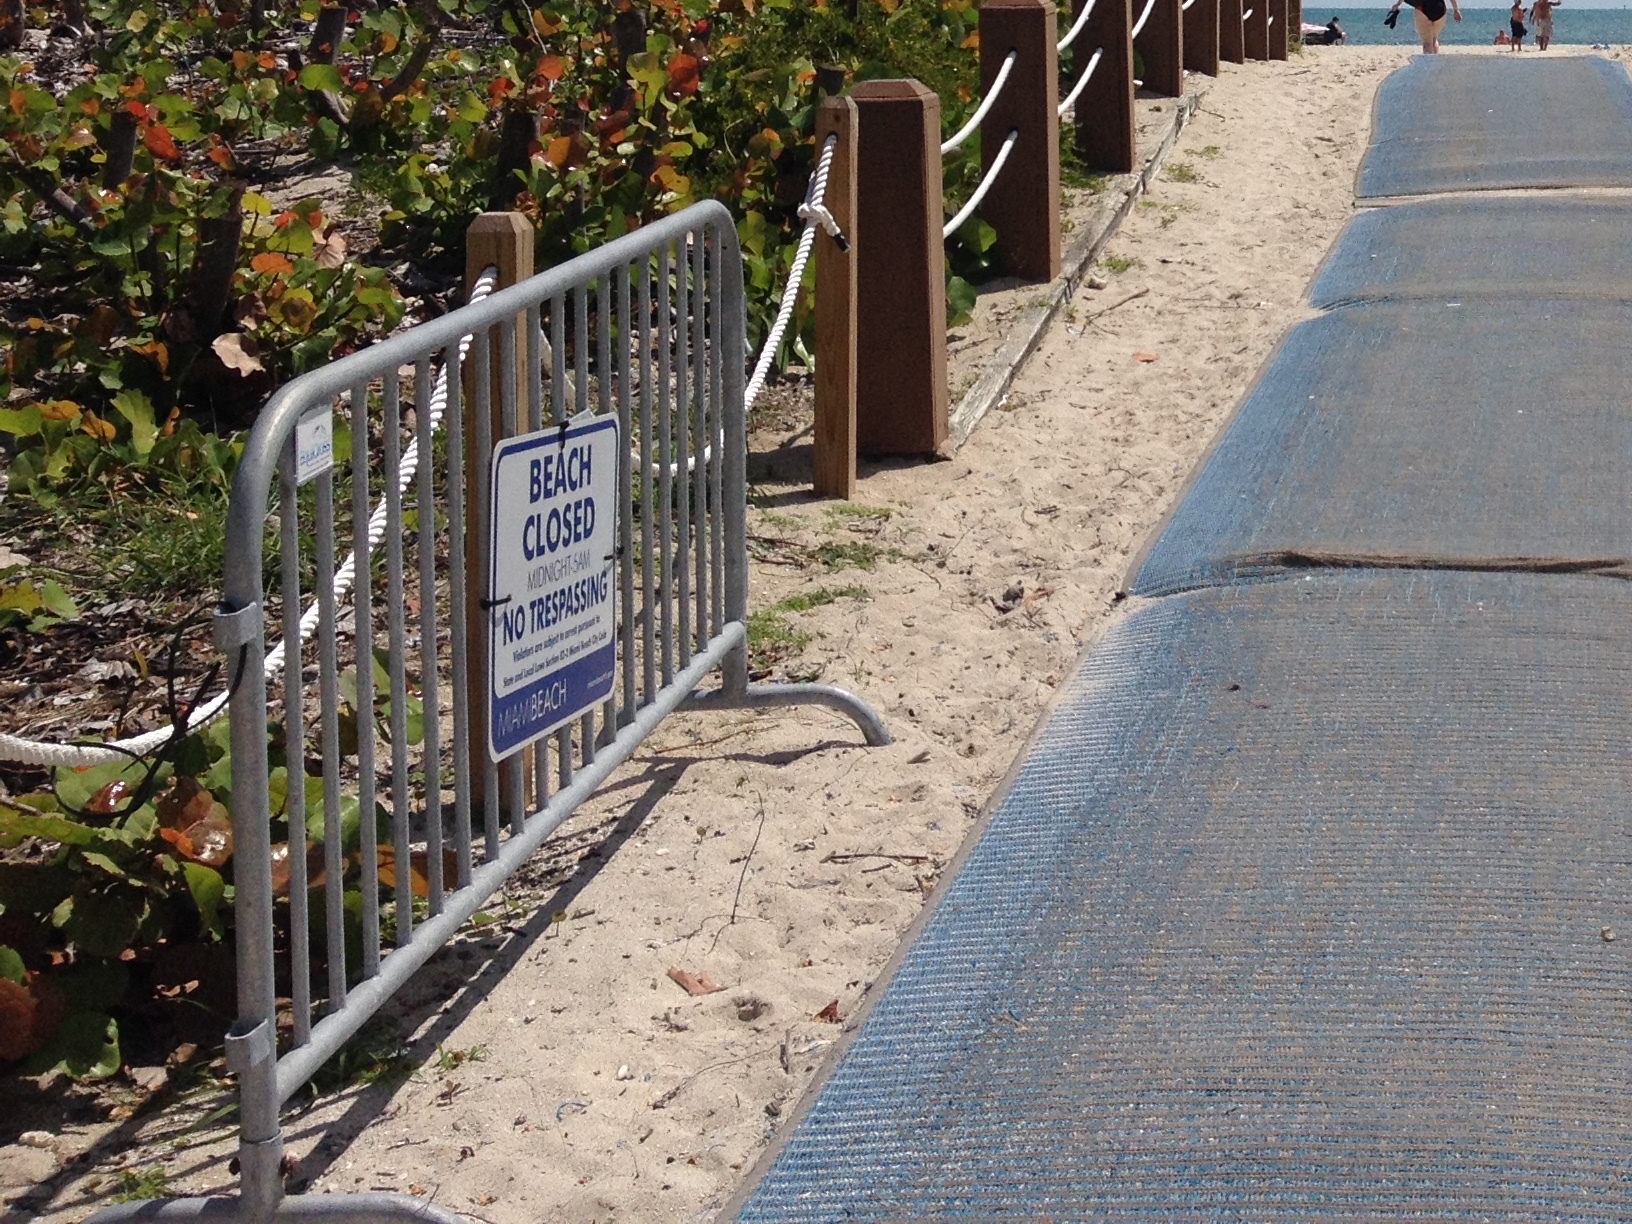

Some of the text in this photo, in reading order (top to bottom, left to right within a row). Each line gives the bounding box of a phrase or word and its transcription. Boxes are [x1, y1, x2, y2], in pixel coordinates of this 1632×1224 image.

[530, 444, 592, 504] BEACH
[523, 496, 595, 561] CLOSED
[503, 570, 608, 646] NO TRESPASSING
[531, 678, 567, 720] BEACH
